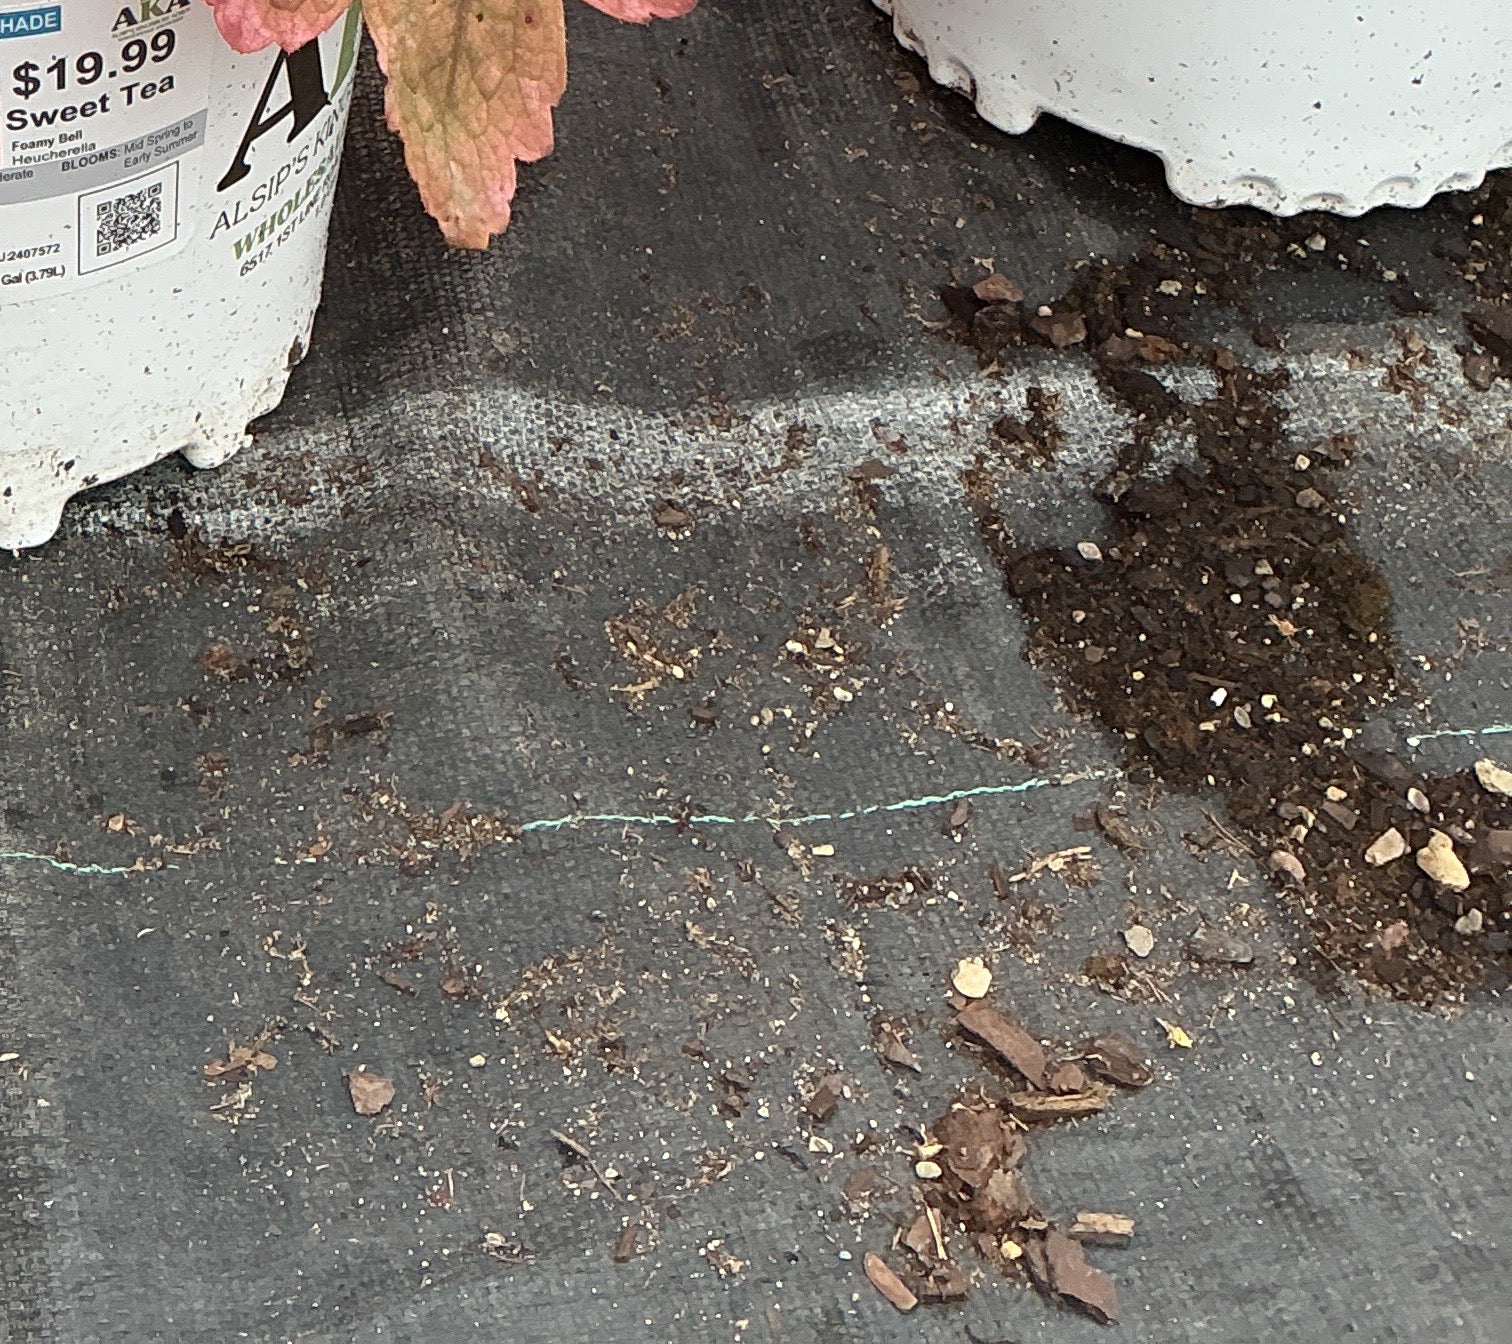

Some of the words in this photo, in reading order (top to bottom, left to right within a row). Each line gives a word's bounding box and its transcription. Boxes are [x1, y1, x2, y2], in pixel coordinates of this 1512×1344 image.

[12, 29, 176, 100] $19.99
[5, 93, 111, 131] Sweet
[119, 74, 175, 107] Tea
[11, 136, 55, 152] Foamy
[58, 129, 83, 144] Bell
[12, 141, 96, 165] Heucherella
[61, 148, 120, 172] BLOOMS:
[124, 137, 144, 153] Mid
[147, 124, 180, 146] Spring
[182, 120, 194, 132] to
[124, 151, 151, 169] Early
[155, 132, 198, 157] Summer
[209, 145, 310, 241] ALSIP'S
[1, 272, 23, 286] Gal
[25, 264, 66, 285] (3.79L)
[240, 242, 273, 277] 6517
